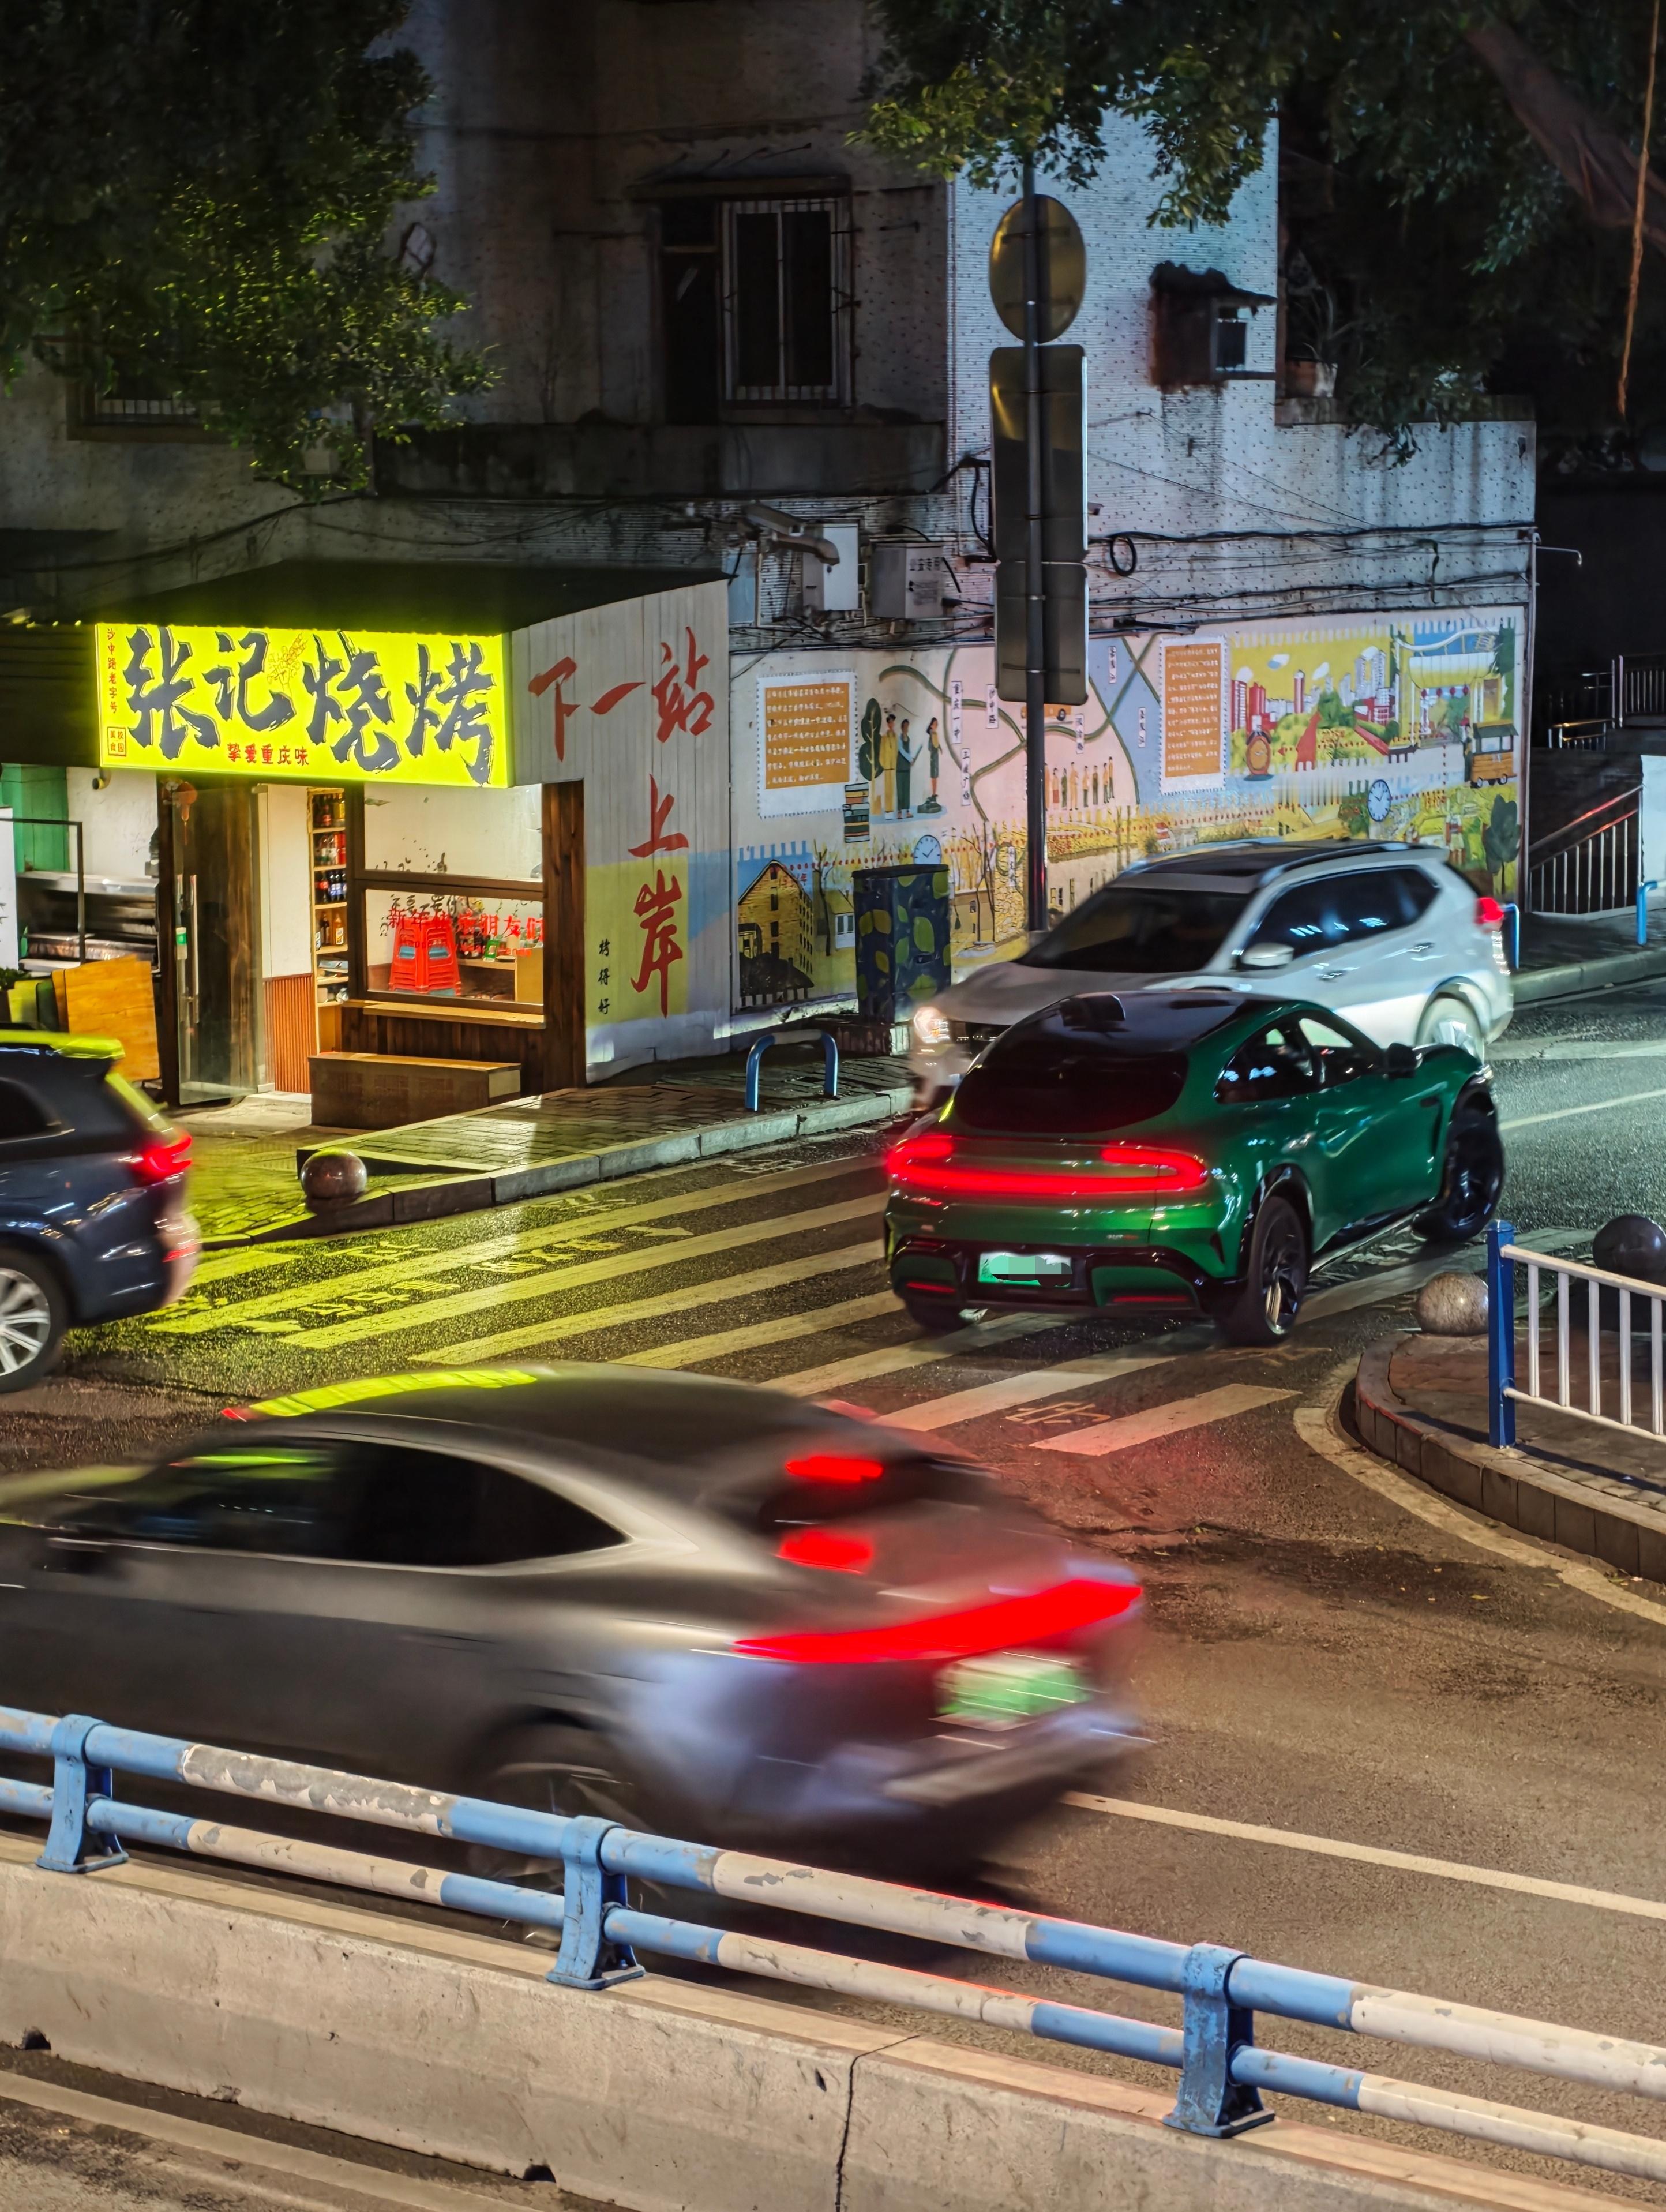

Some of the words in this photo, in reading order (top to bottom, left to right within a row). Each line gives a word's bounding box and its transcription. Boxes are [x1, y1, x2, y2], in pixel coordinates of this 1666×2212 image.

[107, 628, 117, 714] 沙中路老字号
[123, 625, 497, 788] 张记烧烤
[528, 626, 714, 761] 下一站
[227, 743, 309, 766] 挚爱重庆味
[628, 774, 689, 1019] 上岸
